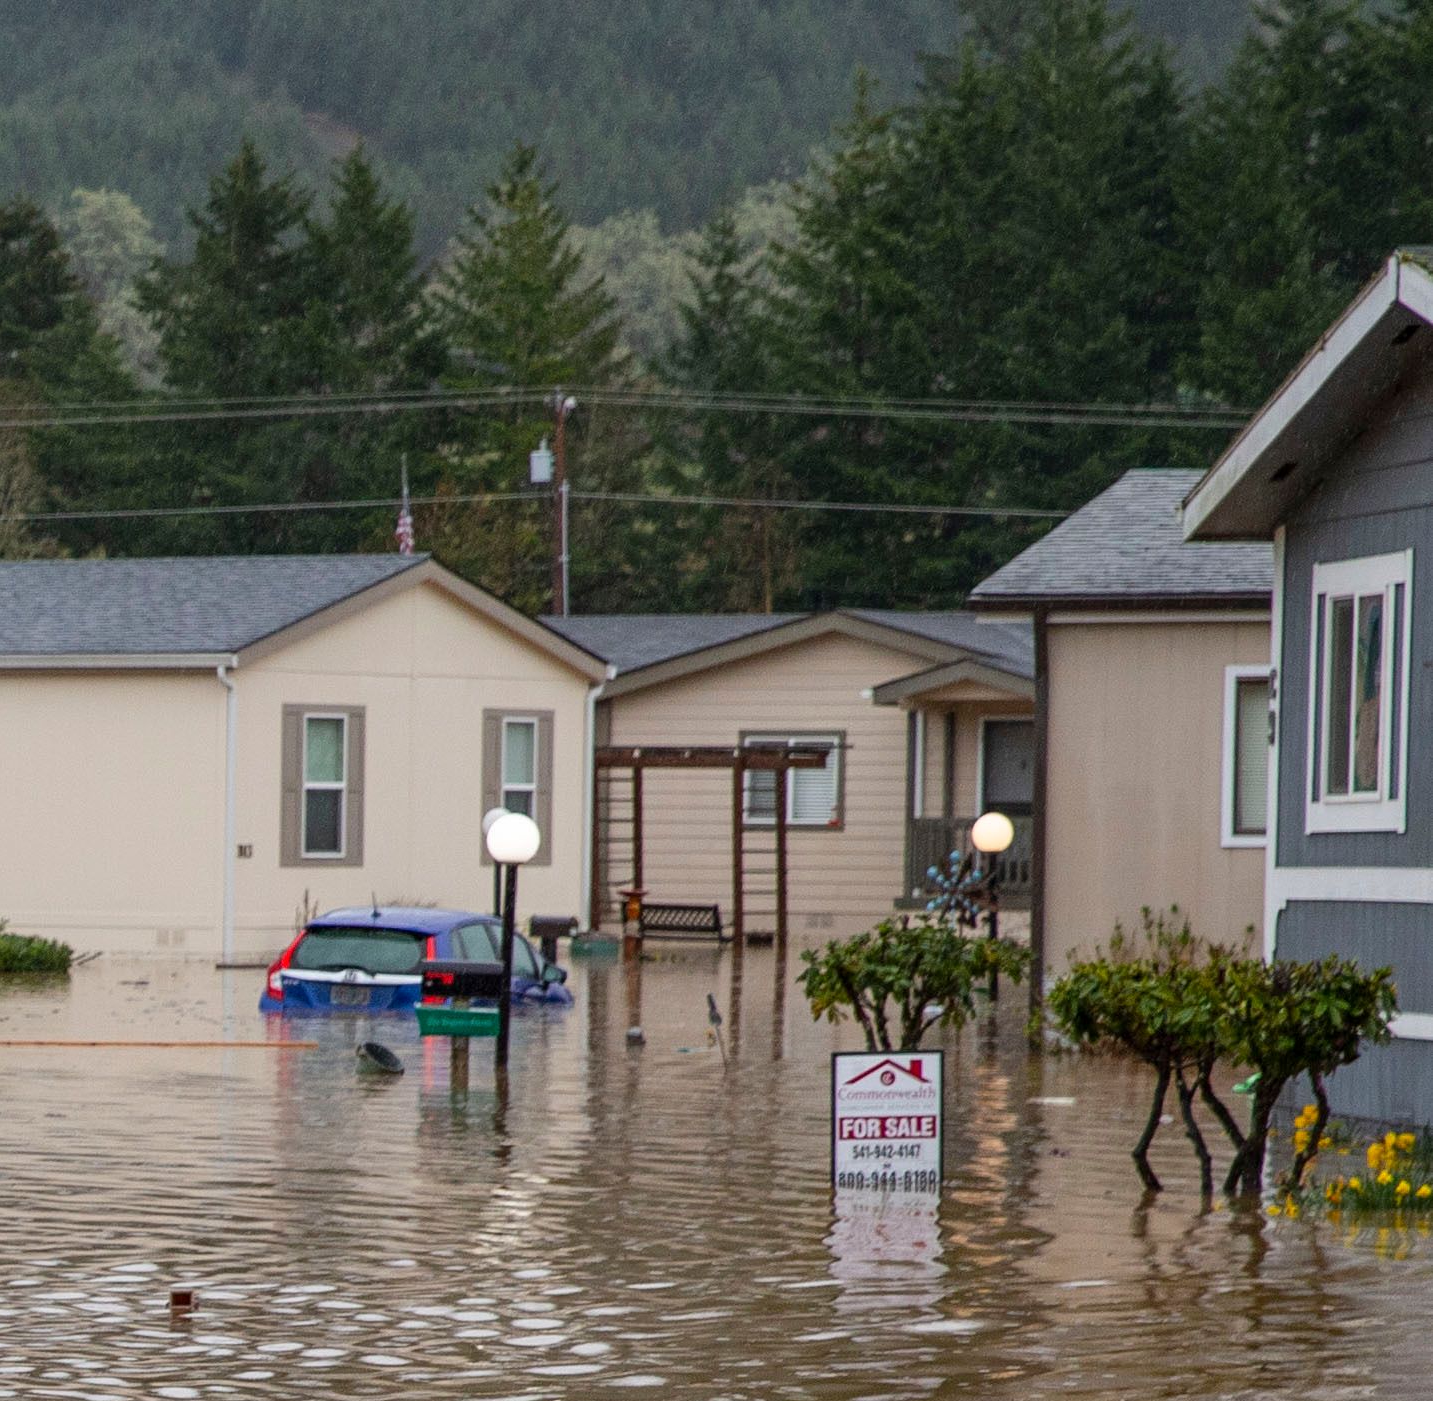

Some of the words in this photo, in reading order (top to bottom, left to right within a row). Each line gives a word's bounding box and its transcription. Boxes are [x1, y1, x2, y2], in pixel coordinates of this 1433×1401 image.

[838, 1086, 937, 1101] Commonwealth
[842, 1118, 881, 1138] FOR
[884, 1116, 934, 1137] SALE
[853, 1144, 921, 1159] 541-942-4147
